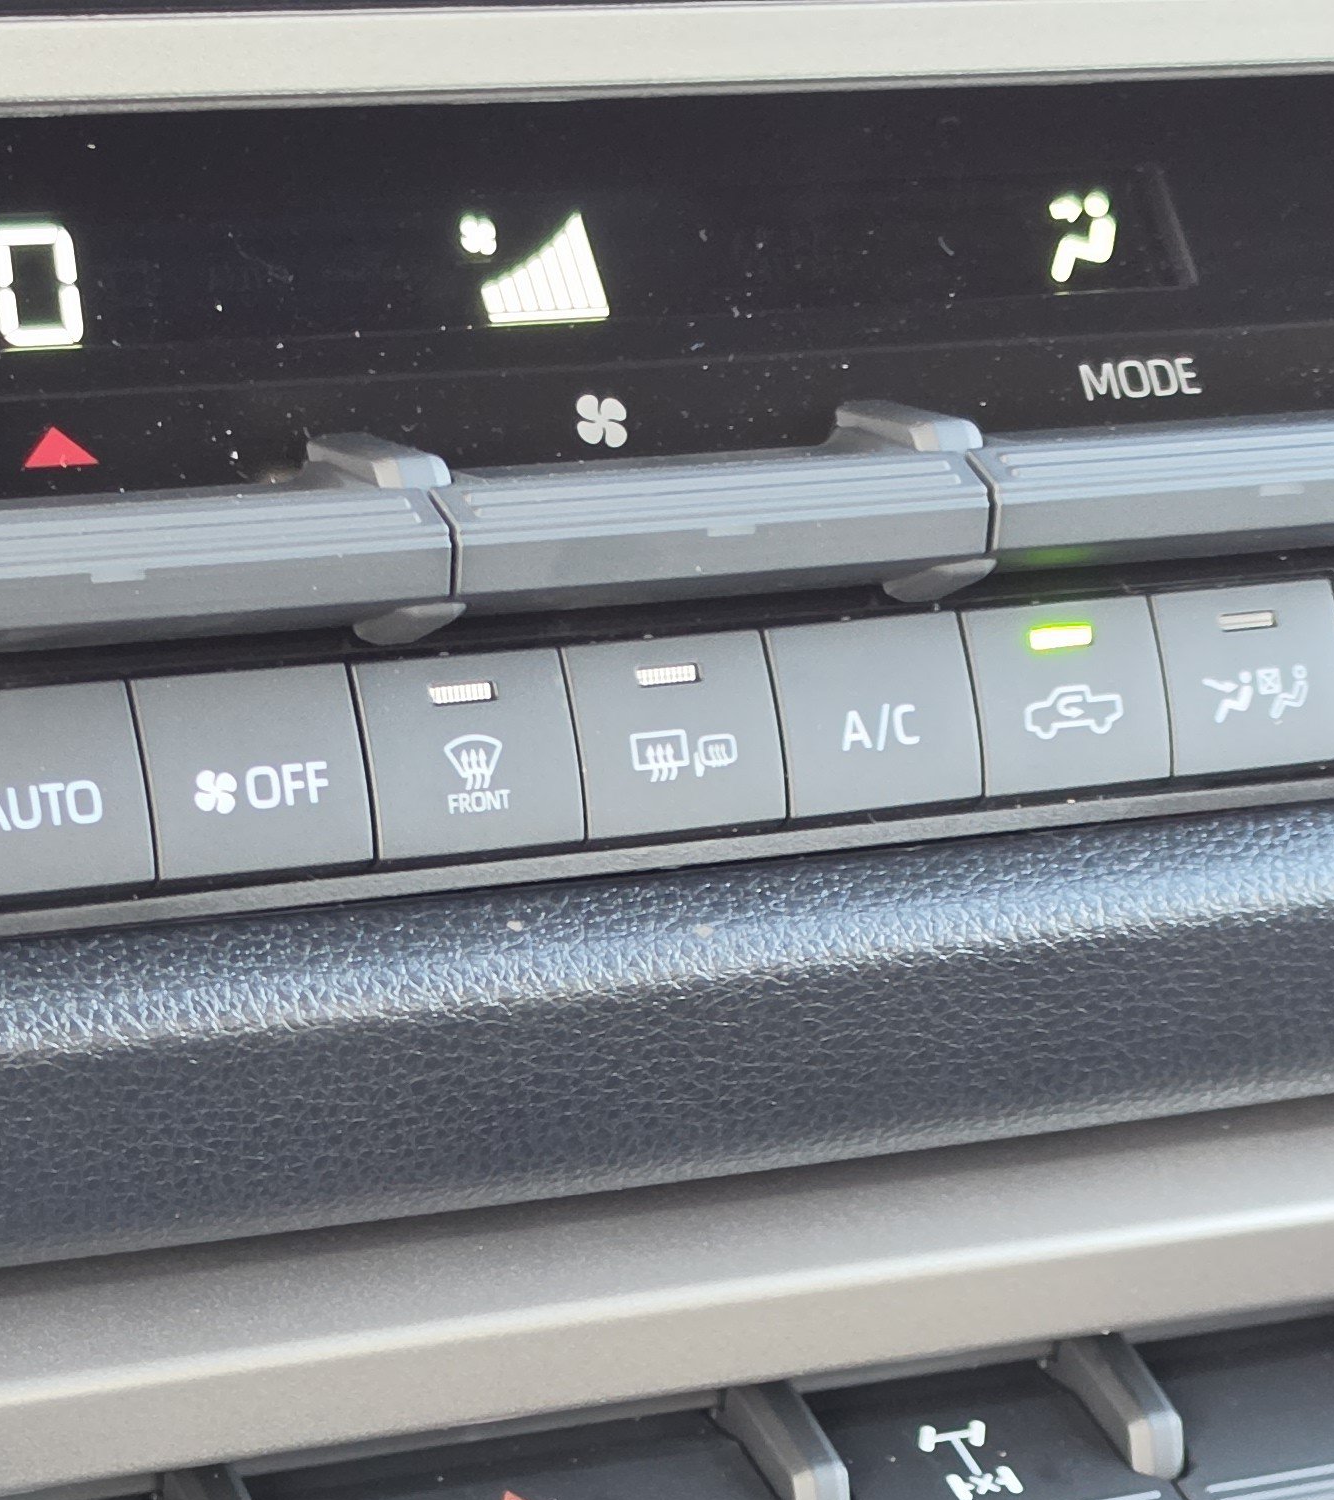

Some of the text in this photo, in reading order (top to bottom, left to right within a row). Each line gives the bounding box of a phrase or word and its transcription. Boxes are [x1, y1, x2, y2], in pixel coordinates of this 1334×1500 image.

[1080, 357, 1203, 403] MODE
[842, 702, 921, 752] A/C
[245, 760, 329, 810] OFF
[447, 787, 511, 815] FRONT
